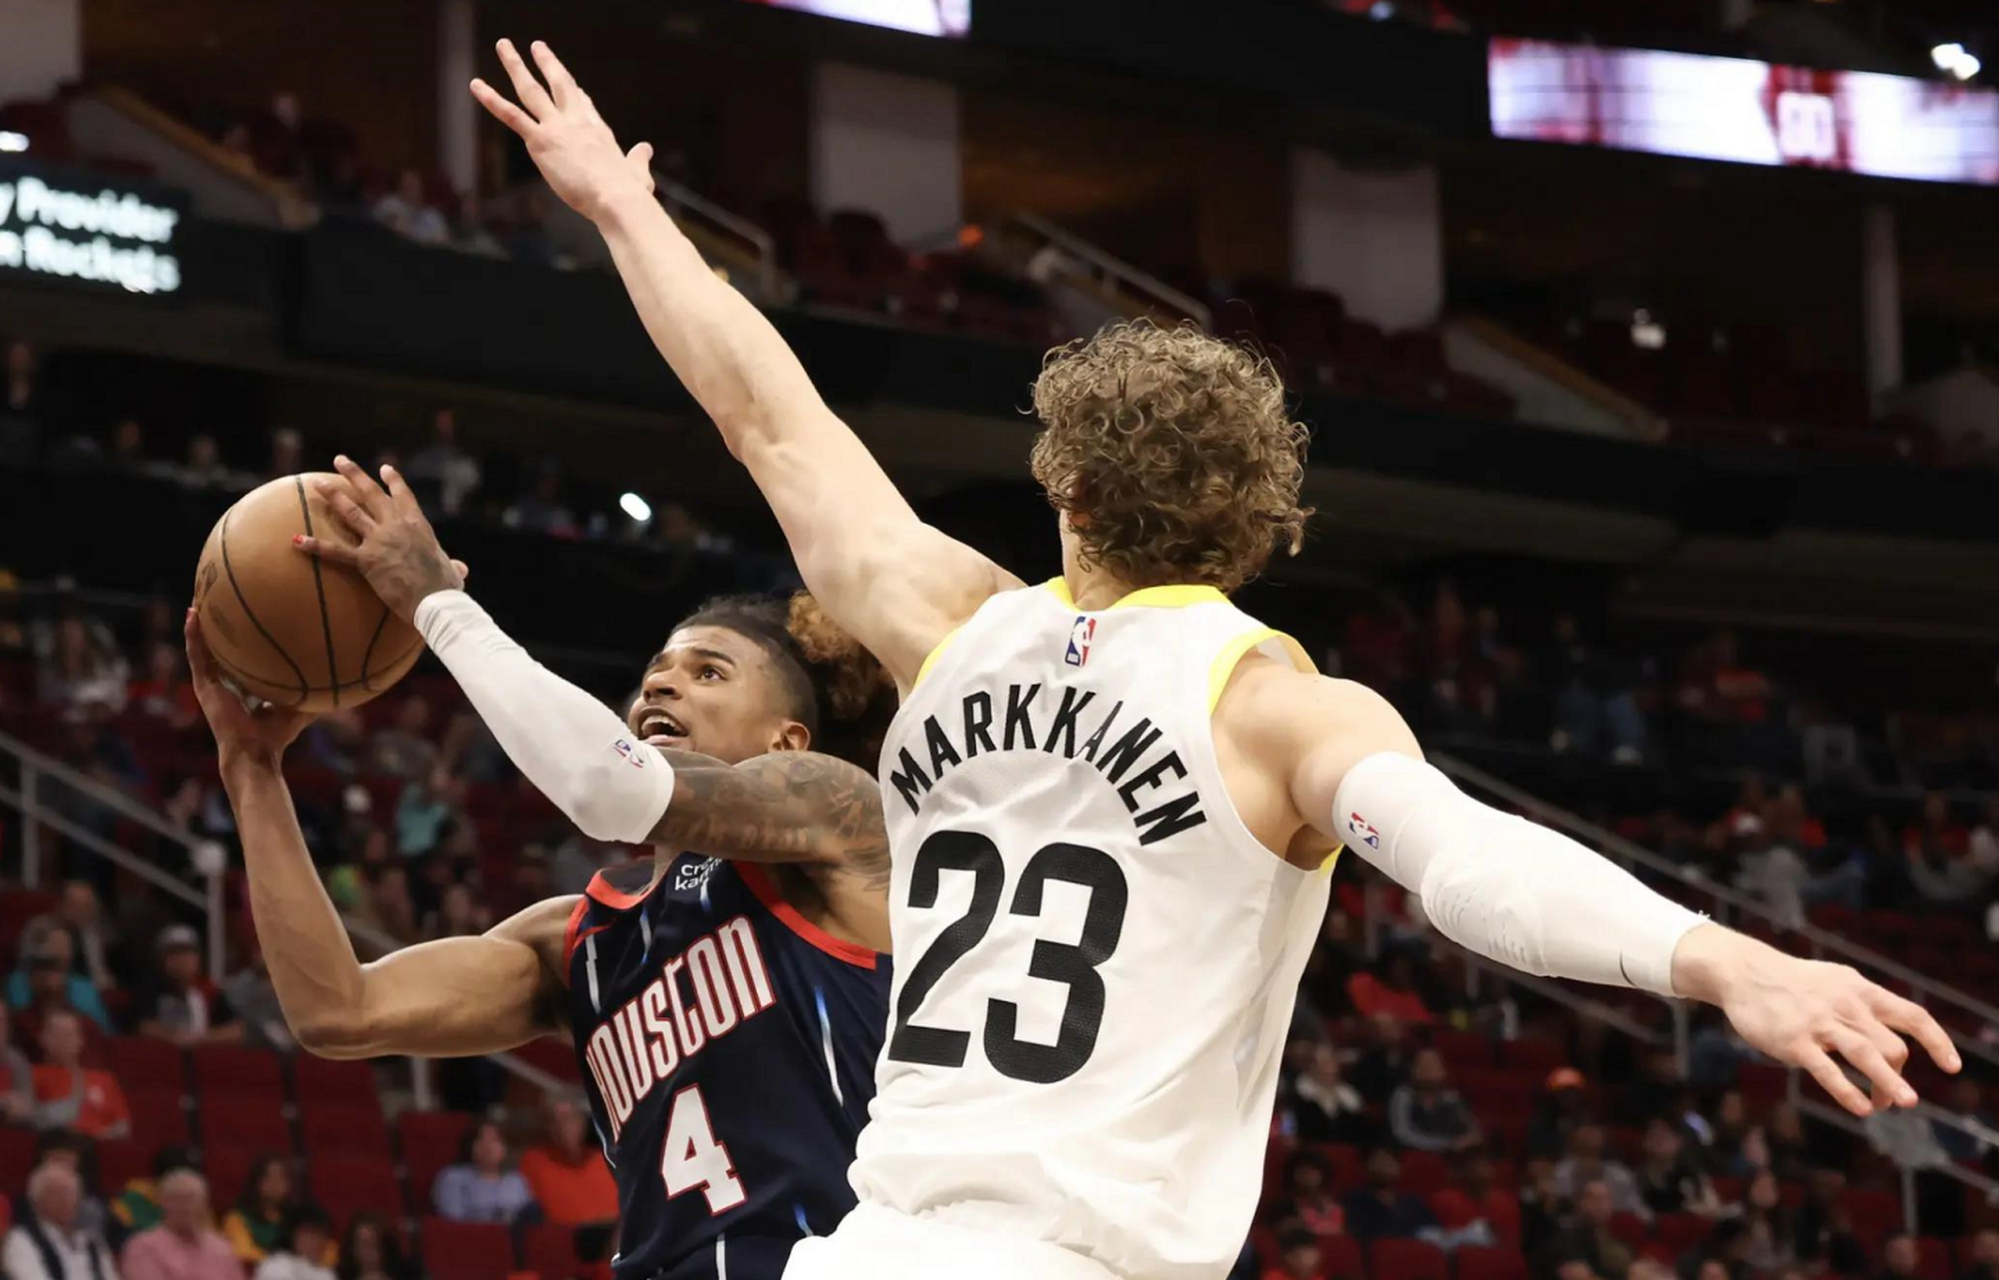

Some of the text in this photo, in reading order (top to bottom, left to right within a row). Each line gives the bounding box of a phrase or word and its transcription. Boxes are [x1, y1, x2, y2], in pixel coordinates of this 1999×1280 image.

[16, 176, 180, 243] Provider
[24, 225, 182, 294] Rockets
[890, 683, 1207, 846] MARKKANEN
[888, 829, 1129, 1084] 23
[661, 1082, 748, 1217] 4
